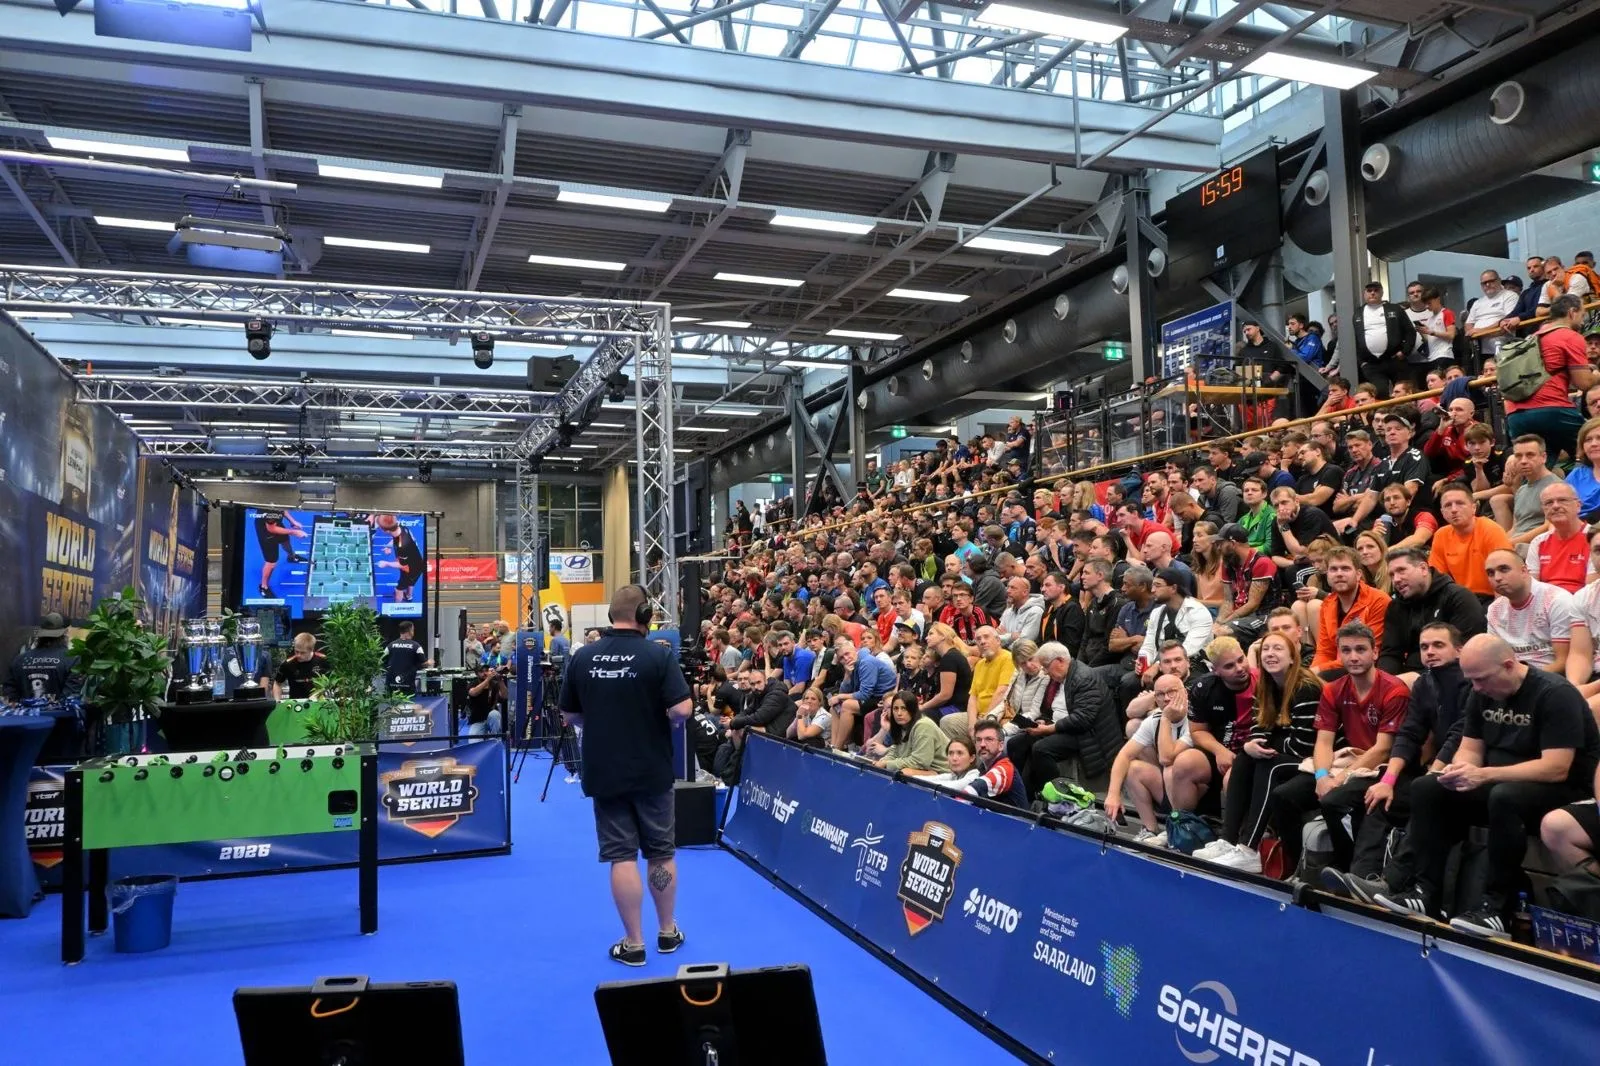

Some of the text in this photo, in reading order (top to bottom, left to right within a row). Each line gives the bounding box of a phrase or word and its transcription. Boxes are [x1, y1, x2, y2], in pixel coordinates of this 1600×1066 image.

[1201, 166, 1243, 207] 15:59
[46, 511, 97, 571] WORLD
[41, 566, 95, 619] SERIES
[592, 654, 636, 662] CREW
[589, 666, 631, 679] itsf
[391, 715, 426, 725] WORLD
[1482, 708, 1533, 727] adidas
[389, 723, 426, 733] SERIES
[398, 779, 463, 797] WORLD
[397, 792, 463, 812] SERIES
[772, 790, 800, 824] itsf
[810, 816, 850, 849] LEONHART
[219, 843, 272, 861] 2026
[912, 851, 950, 883] WORLD
[904, 870, 945, 903] SERIES
[978, 894, 1018, 934] LOTTO
[1044, 906, 1072, 924] Ministerium
[1040, 927, 1062, 943] und Sport
[1060, 924, 1076, 938] Bauen
[1033, 940, 1097, 987] SAARLAND
